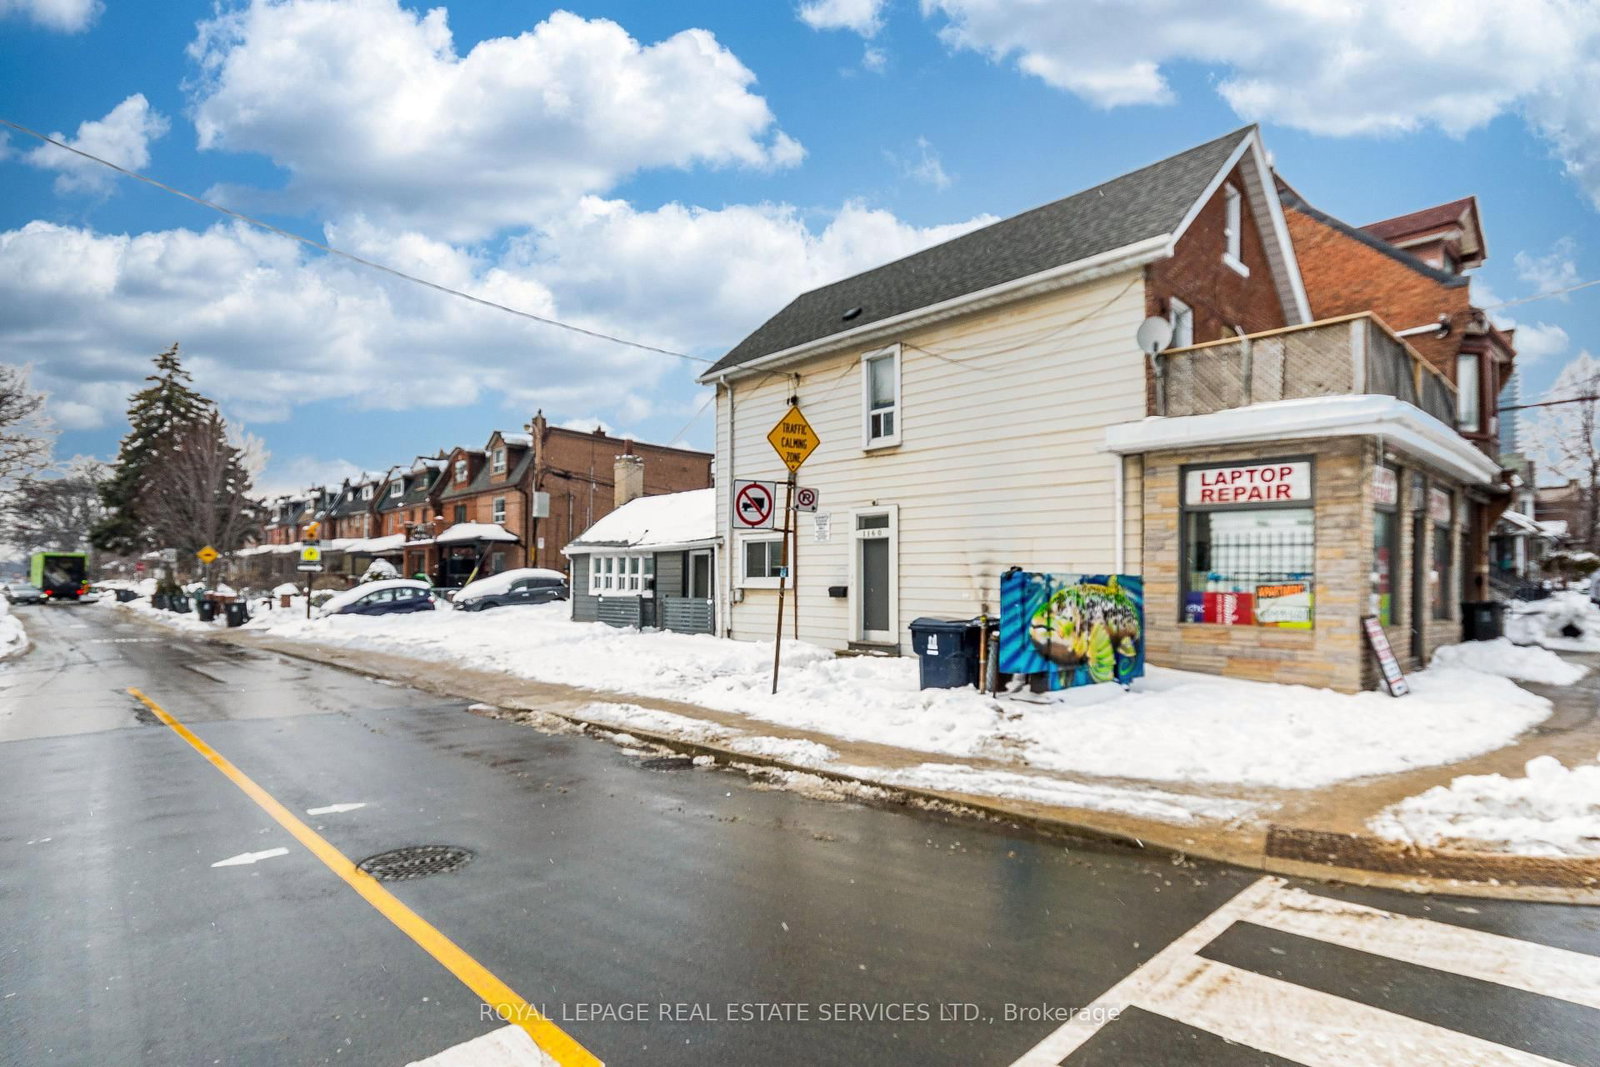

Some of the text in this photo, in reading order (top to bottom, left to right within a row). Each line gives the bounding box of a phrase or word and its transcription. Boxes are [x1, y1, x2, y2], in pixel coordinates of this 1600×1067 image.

[783, 422, 807, 435] TRAFFIC
[781, 436, 807, 450] CALMING
[786, 451, 801, 463] ZONE
[1200, 466, 1293, 487] LAPTOP
[1200, 484, 1292, 502] REPAIR
[862, 529, 883, 539] 1160
